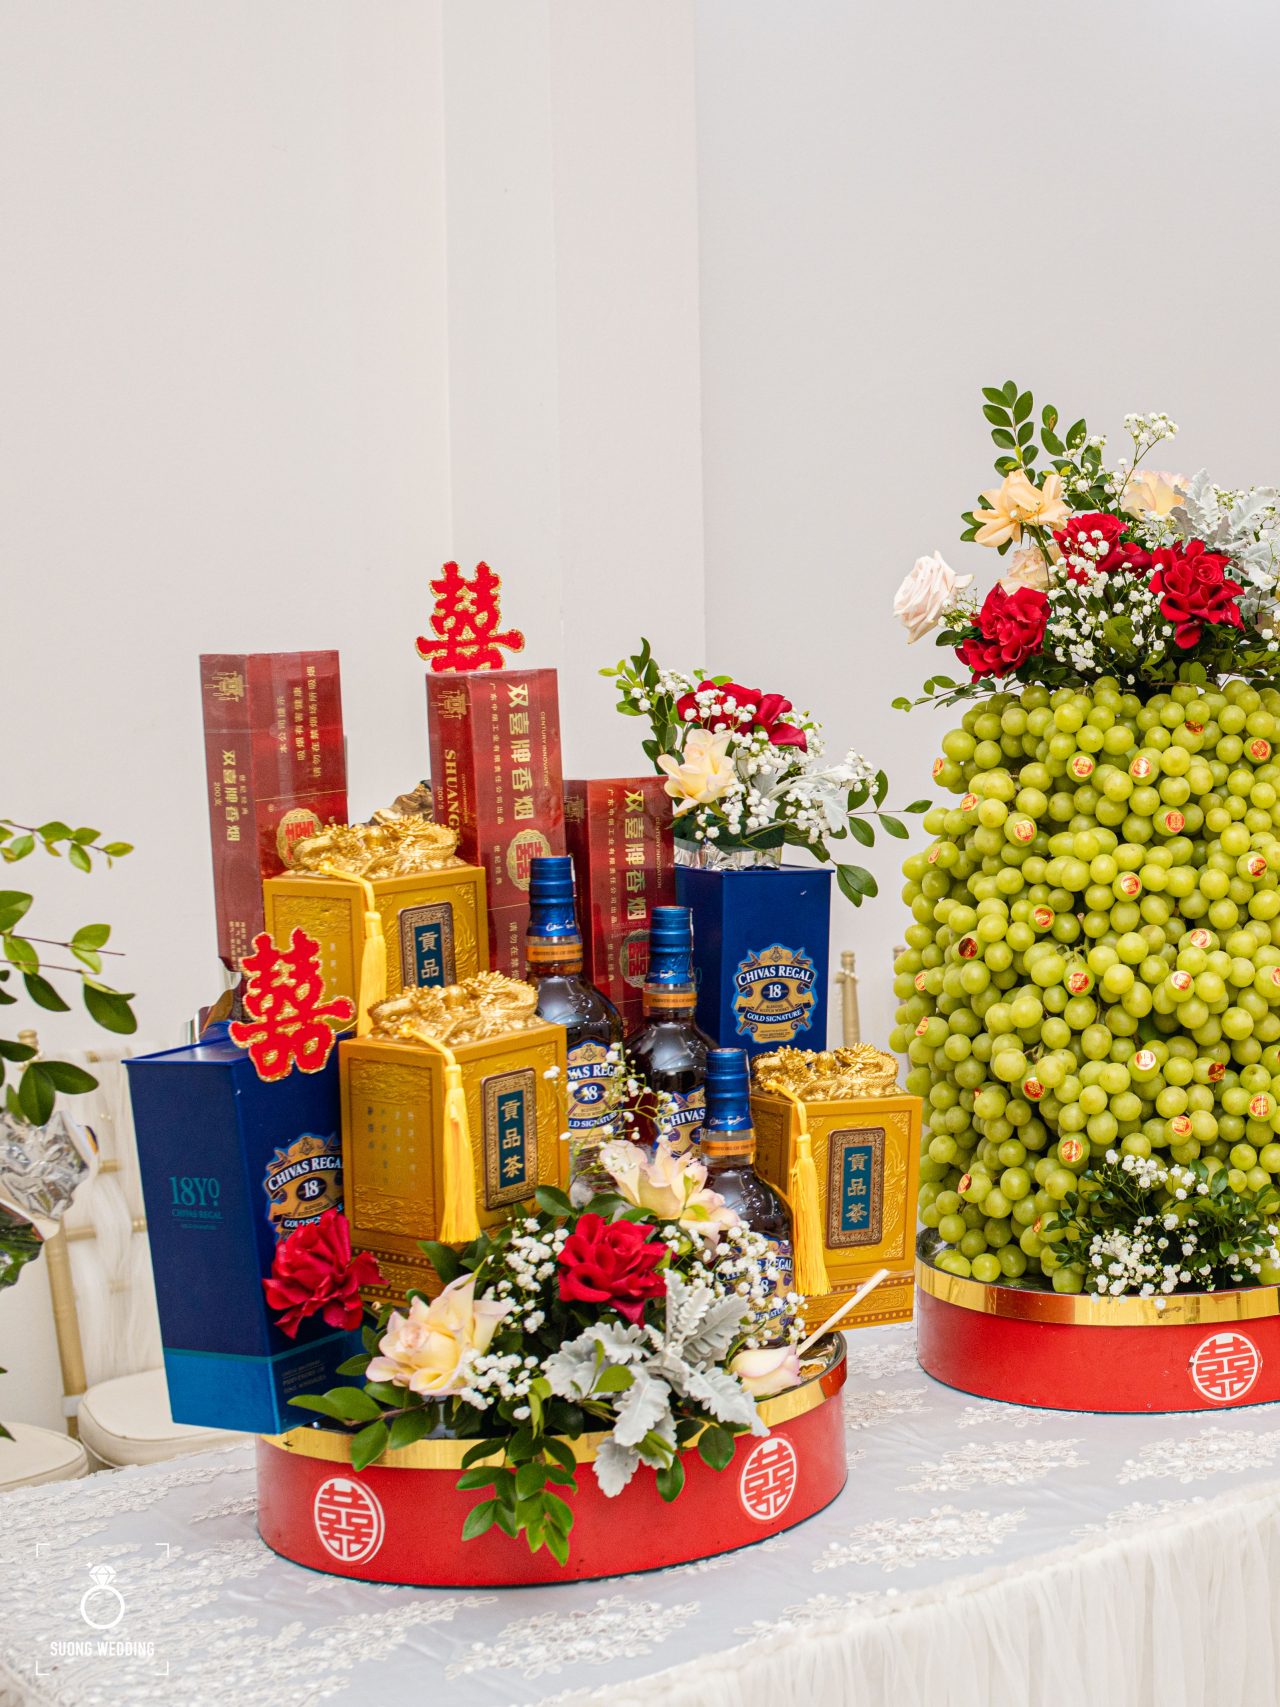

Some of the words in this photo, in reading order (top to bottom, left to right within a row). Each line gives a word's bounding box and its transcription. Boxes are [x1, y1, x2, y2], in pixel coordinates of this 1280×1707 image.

[507, 683, 534, 821] 双喜牌香烟
[624, 790, 647, 920] 双喜牌香烟
[738, 966, 776, 986] CHIVAS
[778, 965, 812, 982] REGAL
[768, 984, 782, 999] 18
[746, 1012, 765, 1022] GOLD
[765, 1009, 802, 1022] SIGNATURE
[500, 1100, 524, 1179] 貢品茶
[268, 1160, 310, 1191] CHIVAS
[311, 1156, 343, 1171] REGA
[303, 1180, 319, 1198] 18
[847, 1153, 868, 1222] 貢品茶
